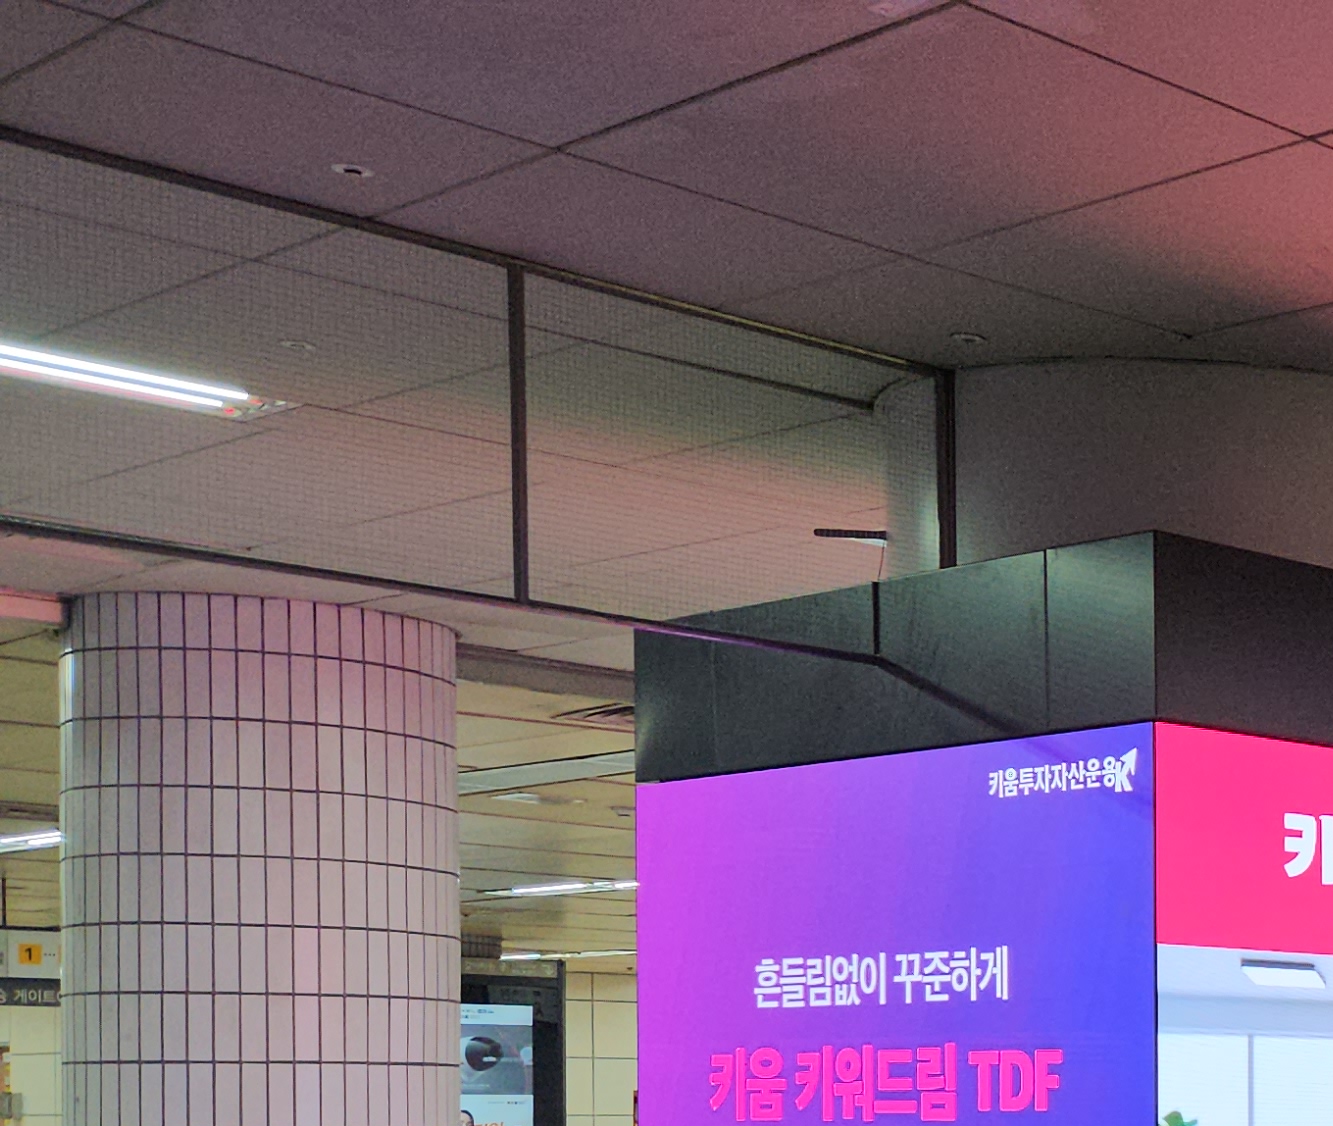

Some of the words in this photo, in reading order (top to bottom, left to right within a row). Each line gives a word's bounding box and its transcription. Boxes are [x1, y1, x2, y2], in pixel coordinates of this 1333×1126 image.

[989, 756, 1116, 798] 키움투자자산운용
[24, 947, 32, 961] 1
[754, 950, 887, 1009] 흔들림없이
[893, 945, 1009, 1004] 꾸준하게
[708, 1047, 786, 1123] 키움
[794, 1043, 957, 1123] 키워드림
[968, 1048, 1064, 1113] TDF
